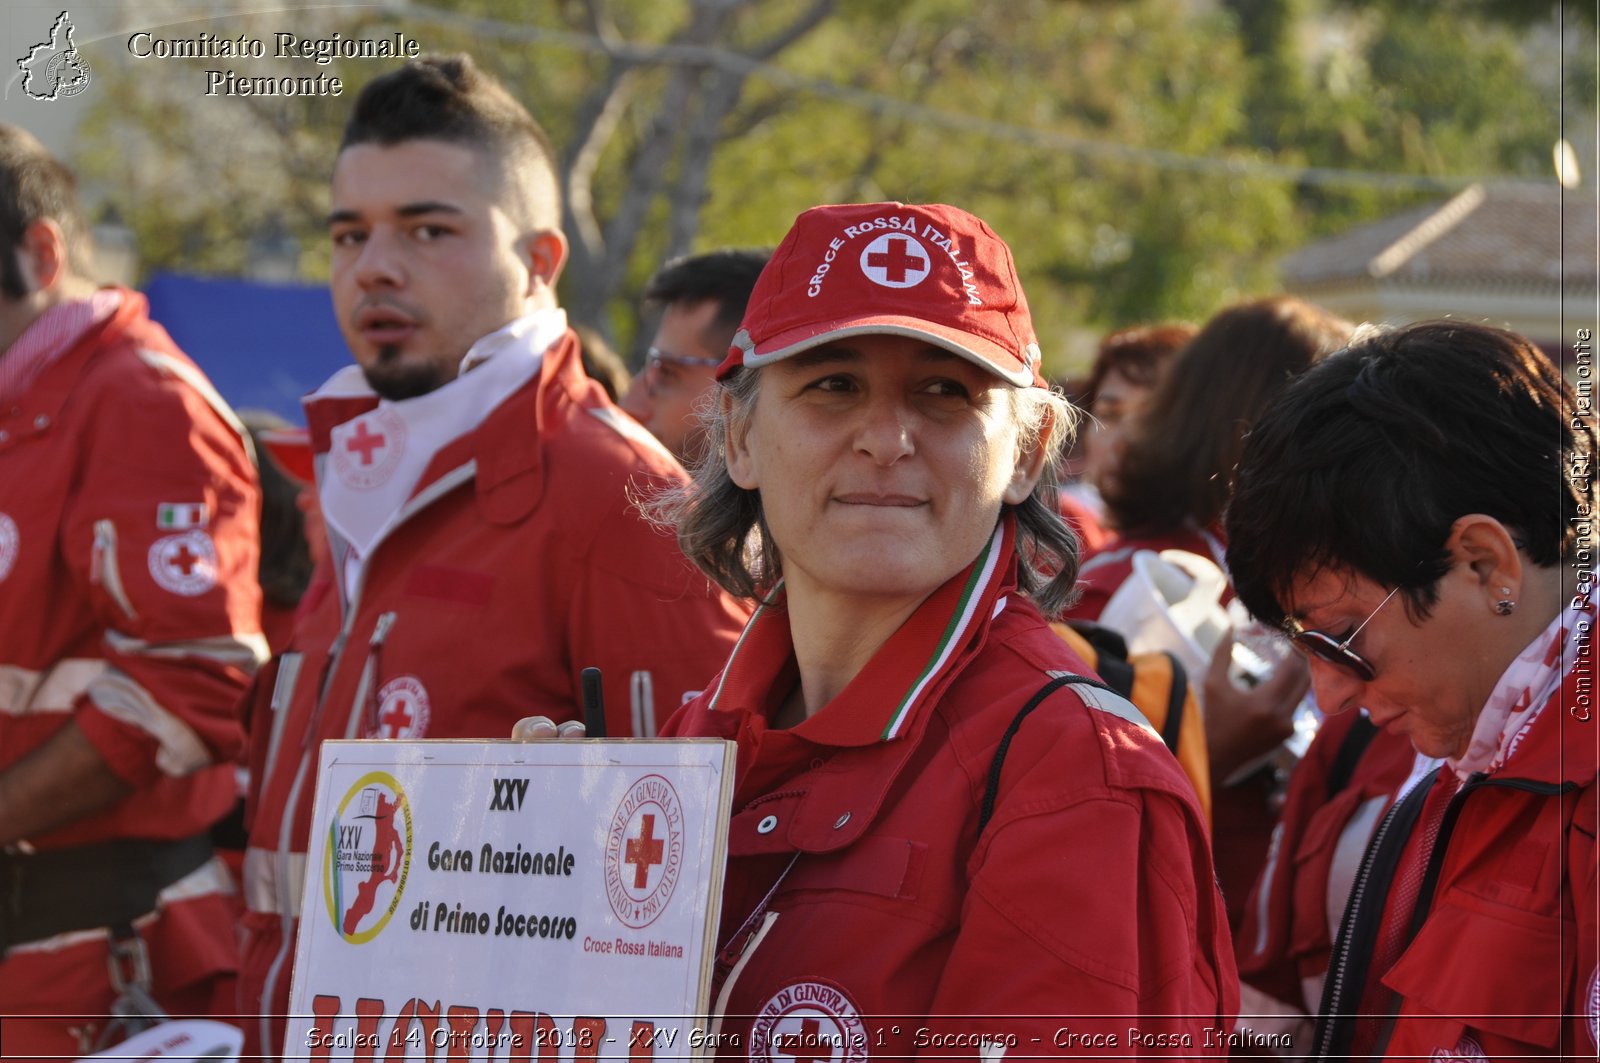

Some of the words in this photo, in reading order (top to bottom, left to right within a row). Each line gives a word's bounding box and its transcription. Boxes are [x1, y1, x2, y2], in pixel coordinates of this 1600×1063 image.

[807, 237, 845, 298] CROCE
[843, 216, 916, 240] ROSSA
[921, 223, 982, 306] ITALIANA
[489, 778, 530, 812] XXV
[624, 799, 635, 816] DI
[635, 781, 672, 812] GINEVRA
[668, 807, 680, 828] 22
[338, 825, 363, 850] XXV
[336, 850, 351, 861] Gara
[353, 851, 383, 863] Nazionale
[336, 861, 355, 872] Primo
[355, 862, 385, 873] Soccorso
[428, 841, 473, 874] Gara
[478, 843, 575, 877] Nazionale
[607, 811, 633, 920] CONVENZIONE
[660, 831, 681, 898] AGOSTO
[397, 860, 410, 895] OTTOBRE
[410, 900, 428, 932] di
[433, 902, 490, 936] Primo
[494, 904, 577, 940] Soccorso
[584, 936, 612, 954] Croce
[615, 938, 645, 957] Rossa
[648, 939, 683, 959] Italiana
[777, 990, 793, 1011] DI
[794, 984, 849, 1015] GINEVRA
